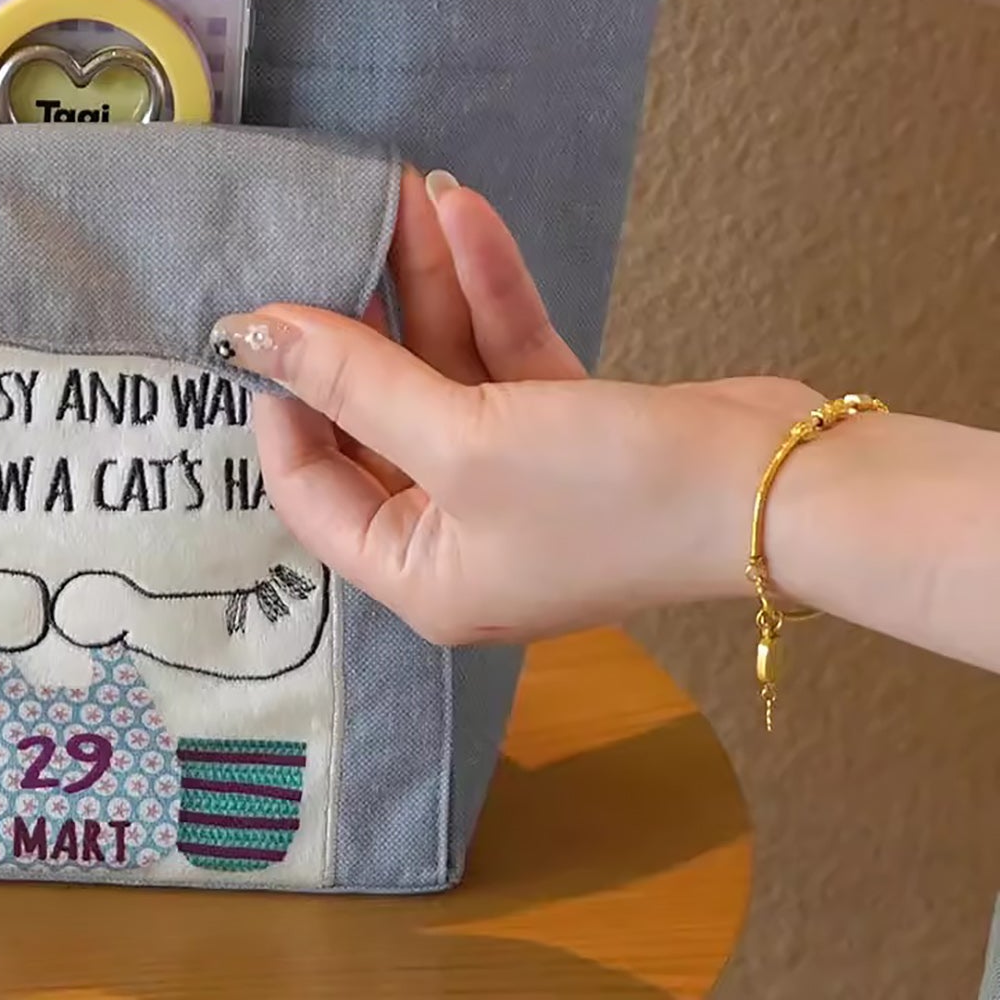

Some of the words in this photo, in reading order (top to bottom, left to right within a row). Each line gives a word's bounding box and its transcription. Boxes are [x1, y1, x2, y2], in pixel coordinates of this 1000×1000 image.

[55, 367, 161, 425] AND
[43, 456, 74, 512] A
[92, 449, 205, 511] CAT'S
[17, 733, 114, 795] 29
[12, 816, 132, 863] MART
